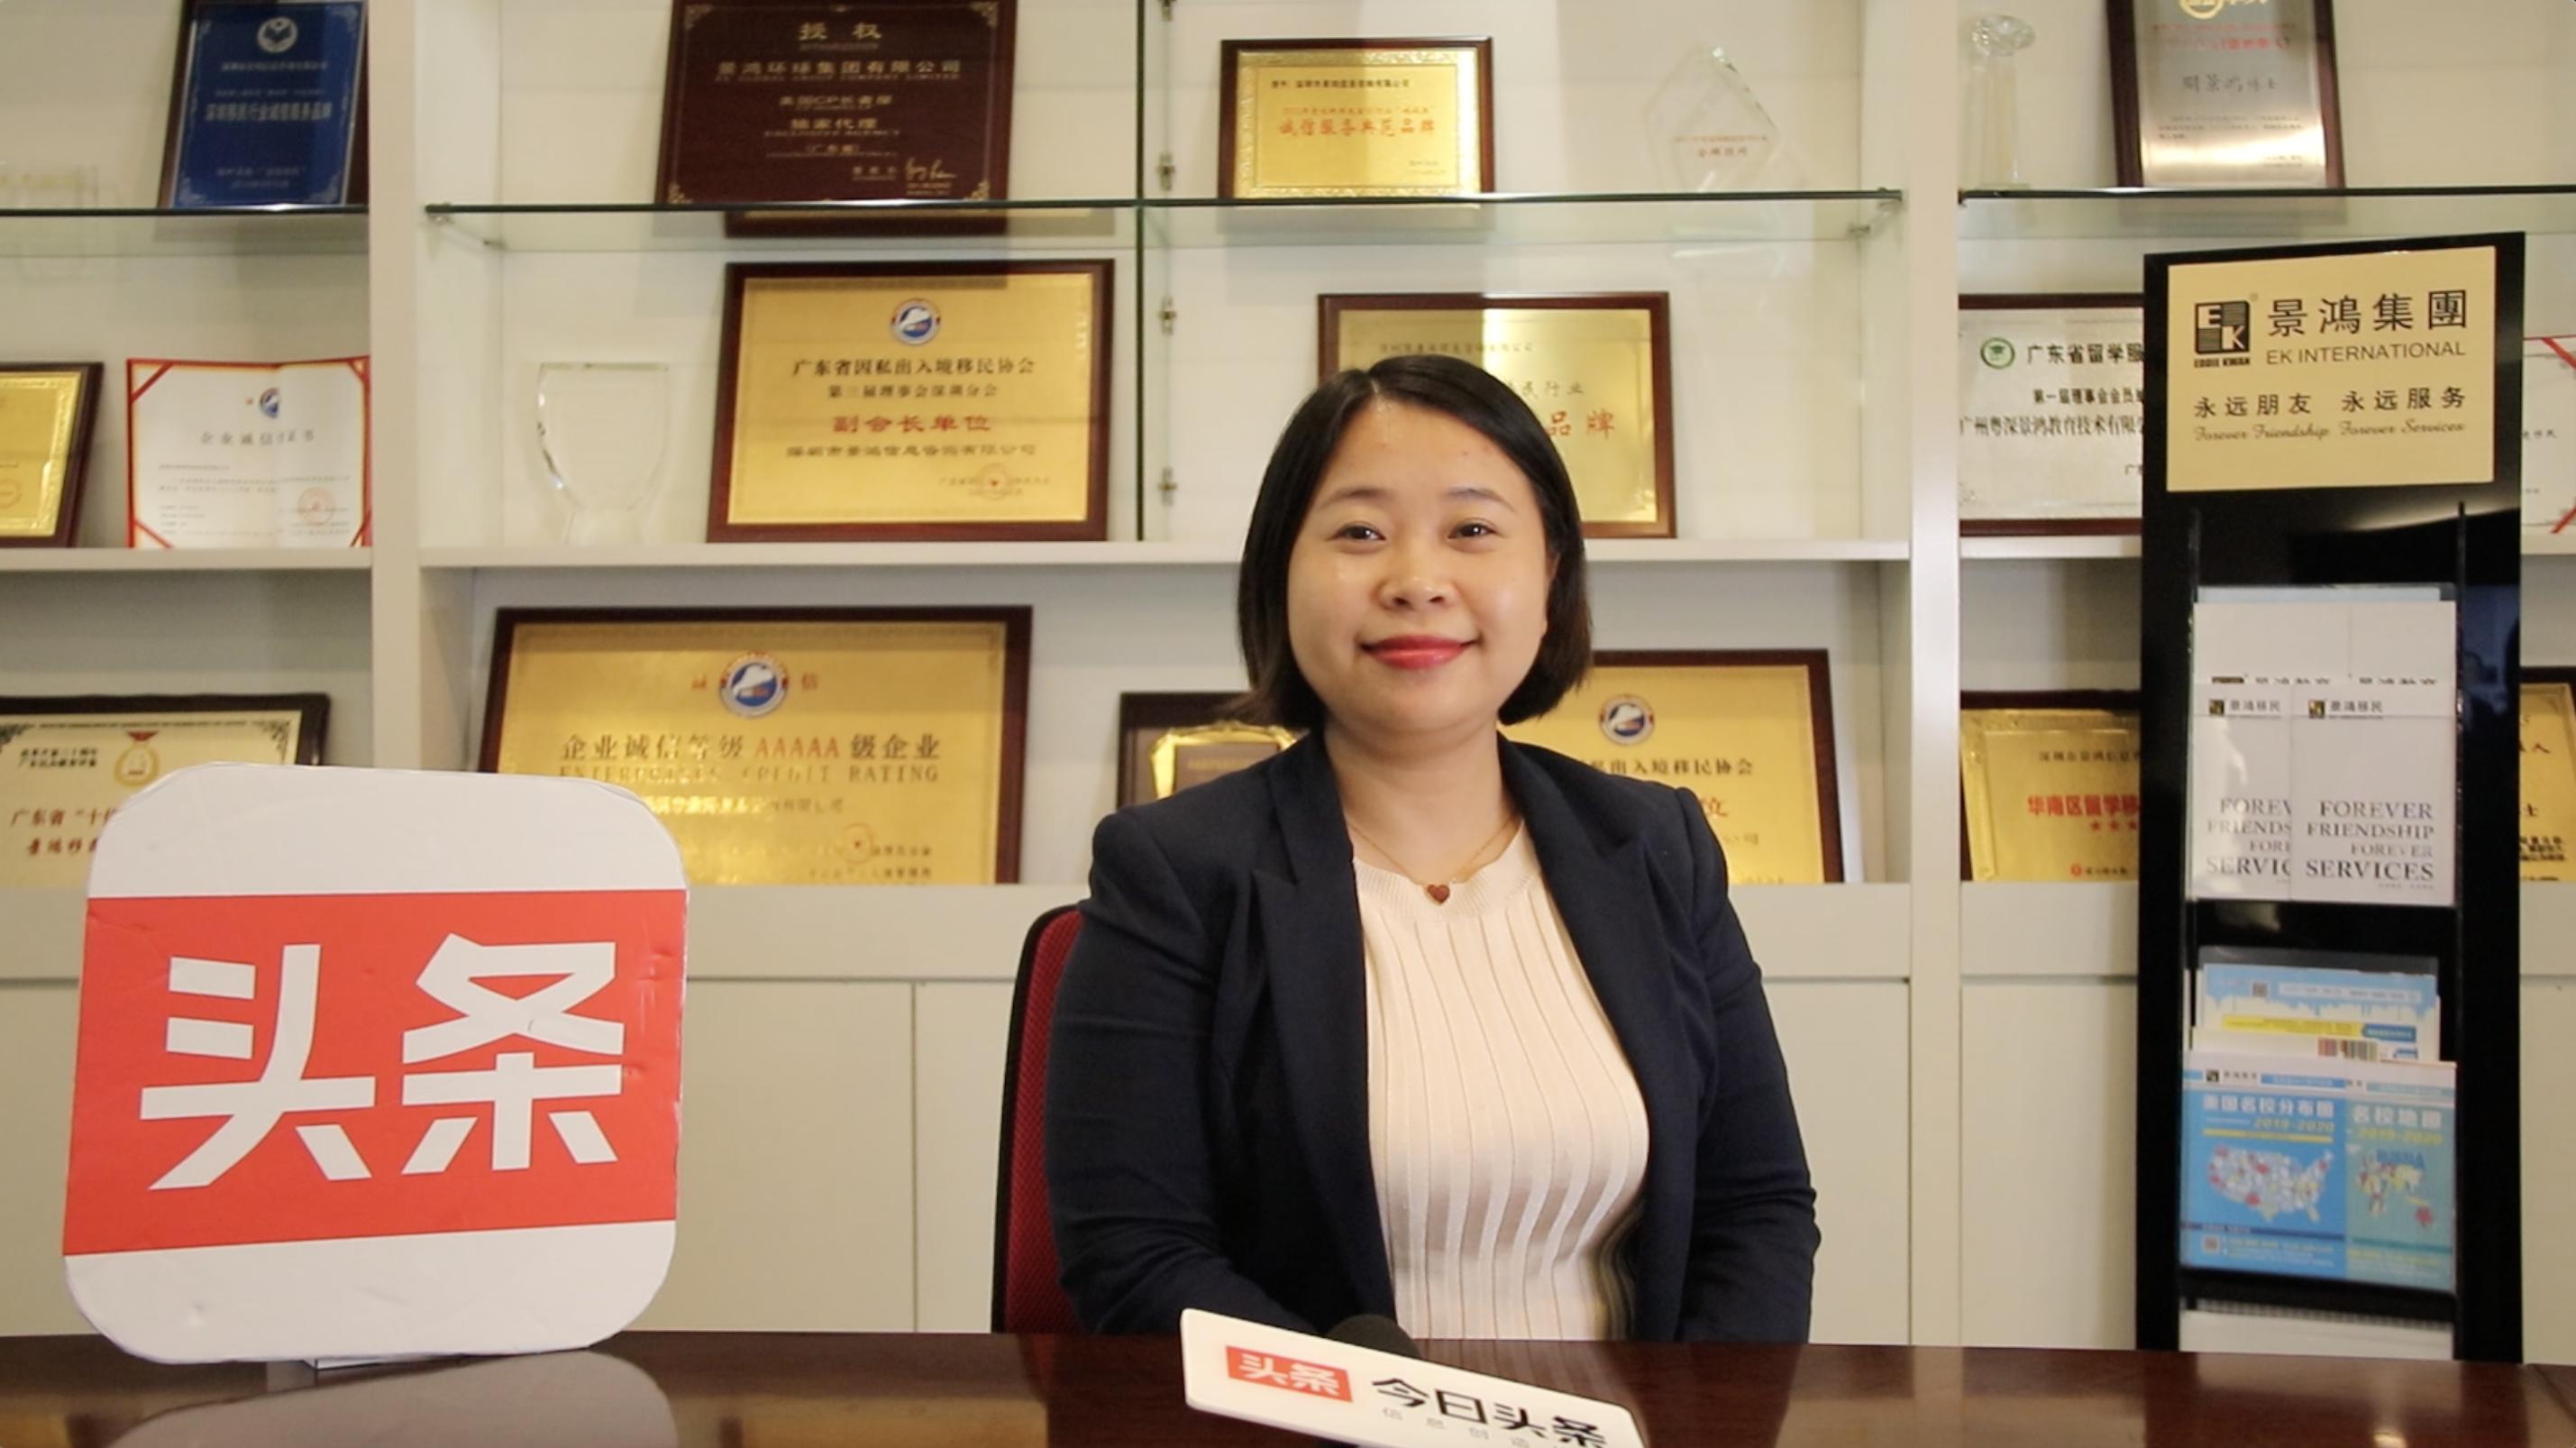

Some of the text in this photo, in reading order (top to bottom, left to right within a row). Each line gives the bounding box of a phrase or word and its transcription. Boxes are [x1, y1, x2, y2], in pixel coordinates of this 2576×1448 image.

[799, 23, 882, 41] 授权
[2267, 289, 2468, 338] 景鴻集團
[2266, 341, 2466, 365] EK INTERNATIONAL
[792, 357, 1035, 376] 广东省因私出入境移民协会
[1508, 380, 1586, 399] 民行业
[2194, 385, 2466, 418] 永远朋友 永远服务
[833, 415, 991, 433] 副会长单位
[1546, 408, 1616, 439] 品牌
[2194, 417, 2467, 441] Forever Friendship Forever Services
[755, 737, 839, 758] AAAAA
[850, 733, 941, 760] 级企业
[848, 765, 939, 783] RATING
[2319, 801, 2434, 819] FOREVER
[2307, 821, 2434, 839] FRIENDSHIP
[2350, 842, 2433, 857] FOREVER
[2305, 858, 2434, 881] SERVICES
[141, 933, 626, 1191] 头条
[2352, 1104, 2442, 1129] 名校地图
[1238, 1354, 1340, 1397] 头条
[1371, 1378, 1608, 1448] 今日头条
